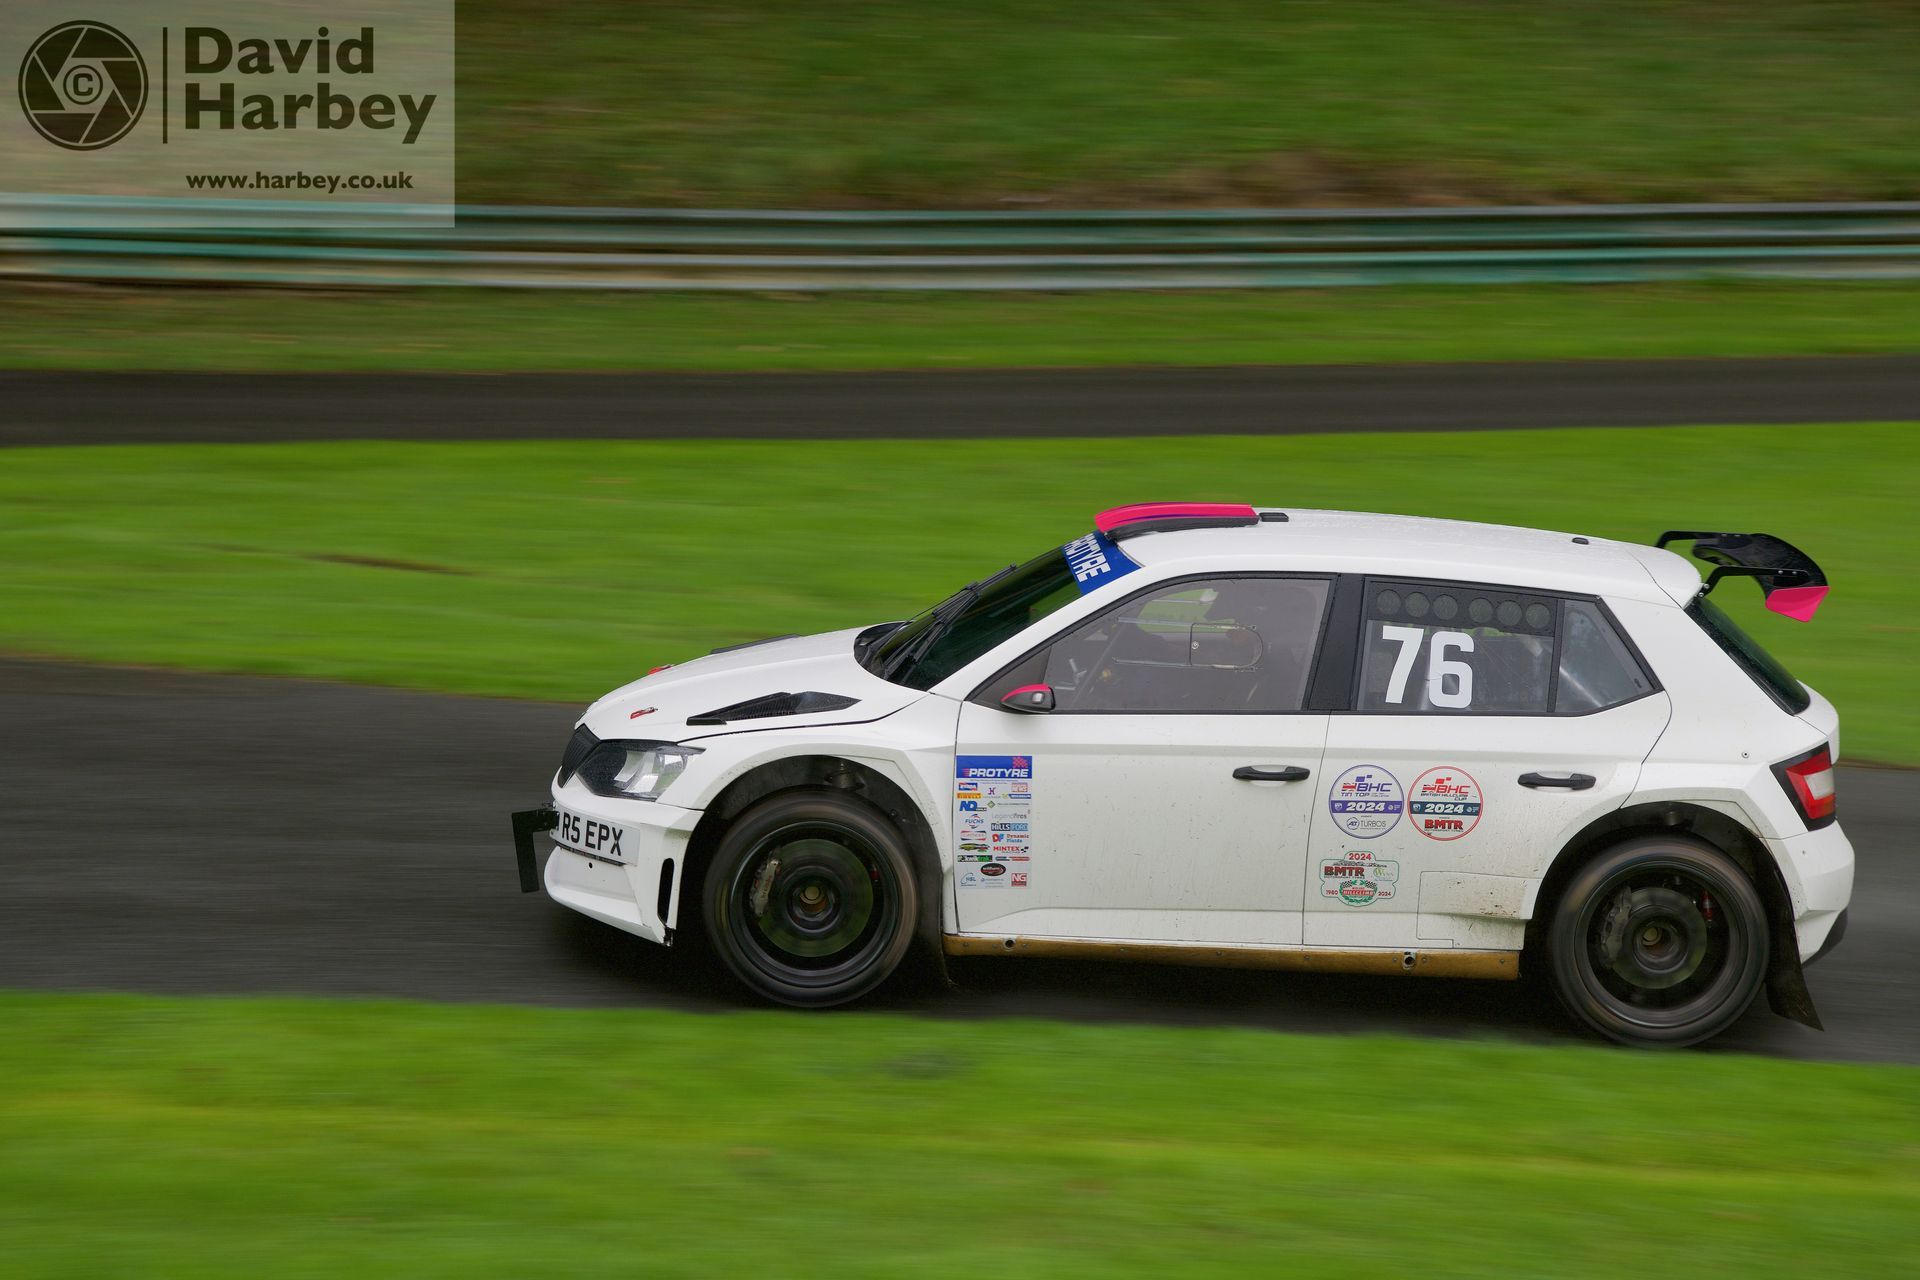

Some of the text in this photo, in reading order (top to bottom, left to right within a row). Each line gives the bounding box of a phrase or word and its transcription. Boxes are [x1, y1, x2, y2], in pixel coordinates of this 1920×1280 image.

[1382, 625, 1474, 708] 76
[968, 768, 1029, 777] PROTYRE
[1357, 783, 1392, 792] BHC
[1436, 785, 1470, 793] BHC
[1346, 802, 1385, 812] 2024
[1425, 803, 1464, 813] 2024
[1424, 819, 1463, 830] BMTR
[562, 812, 623, 856] R5 EPX
[1348, 853, 1372, 861] 2024
[1324, 866, 1365, 877] BMTR
